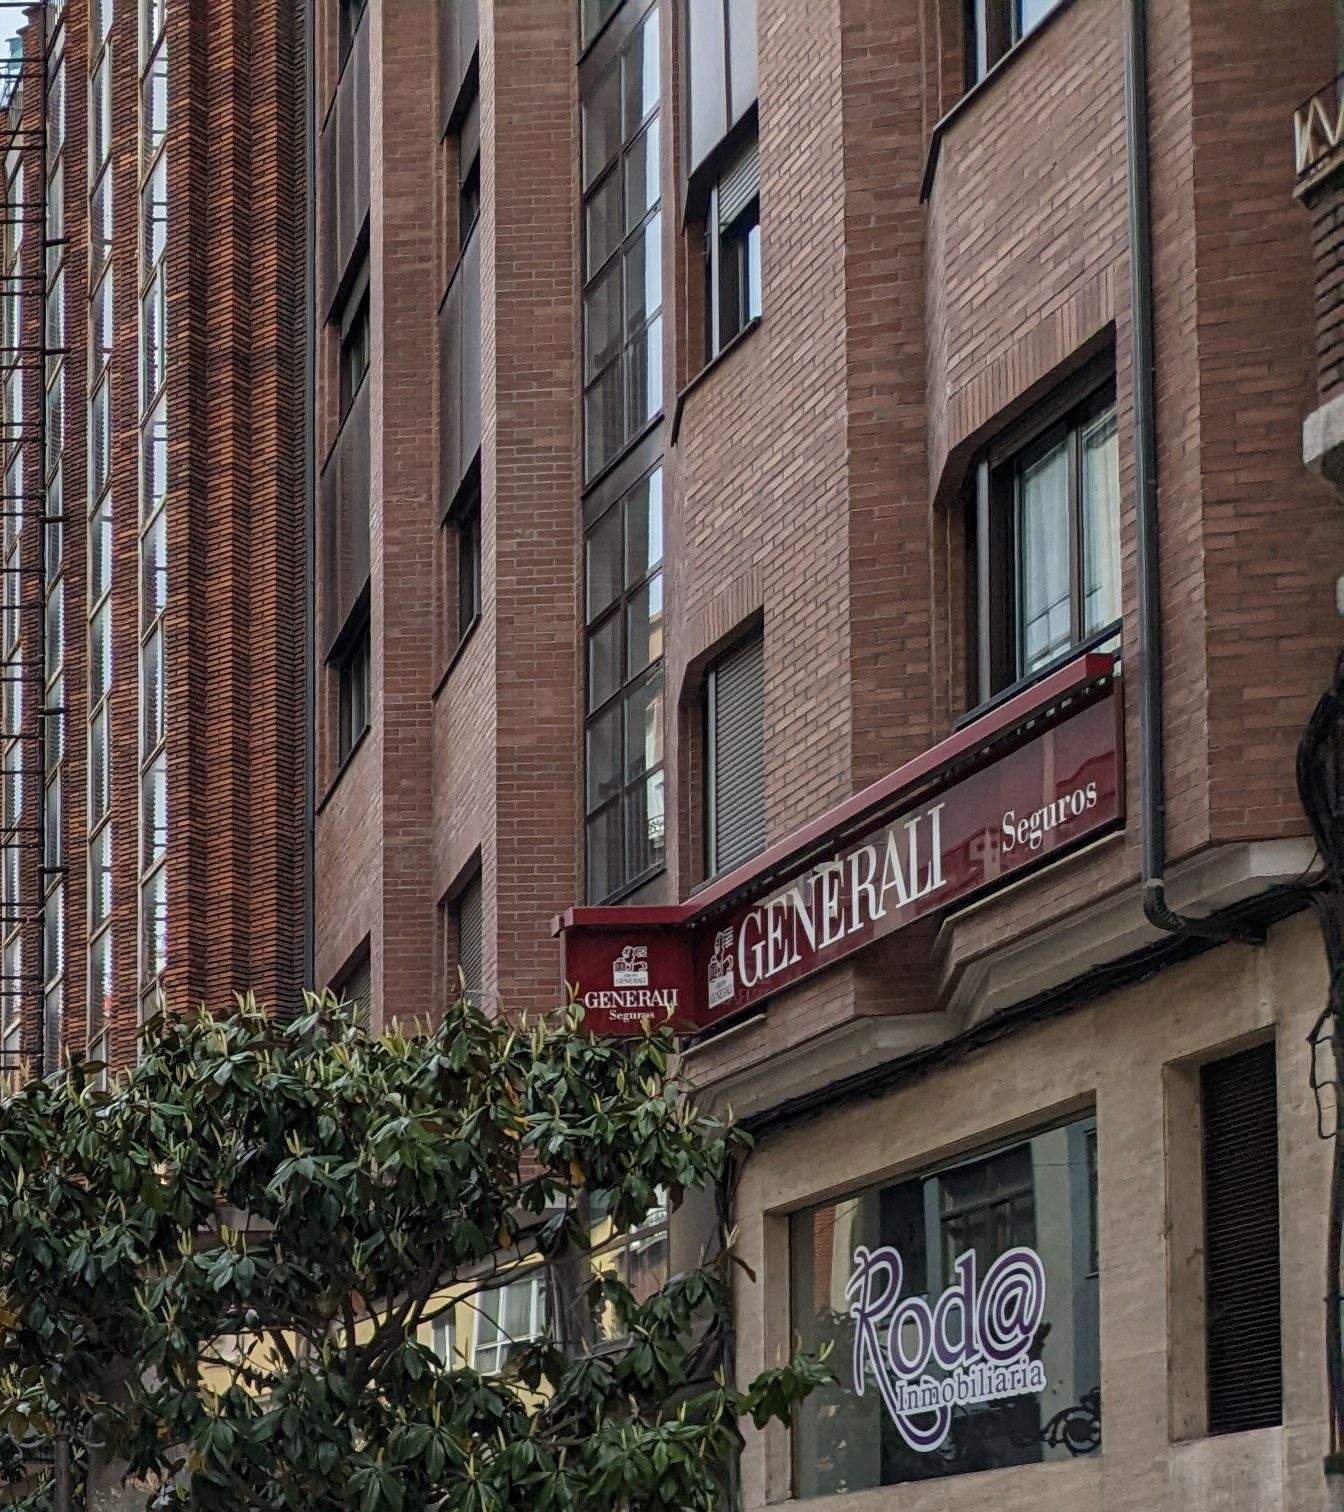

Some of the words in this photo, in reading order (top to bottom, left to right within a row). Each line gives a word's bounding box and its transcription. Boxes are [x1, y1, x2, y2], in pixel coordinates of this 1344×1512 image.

[738, 802, 947, 988] GENERALI
[1002, 780, 1098, 853] Seguros
[584, 989, 679, 1009] GENERALI
[896, 1359, 1046, 1413] Inmobiliaria
